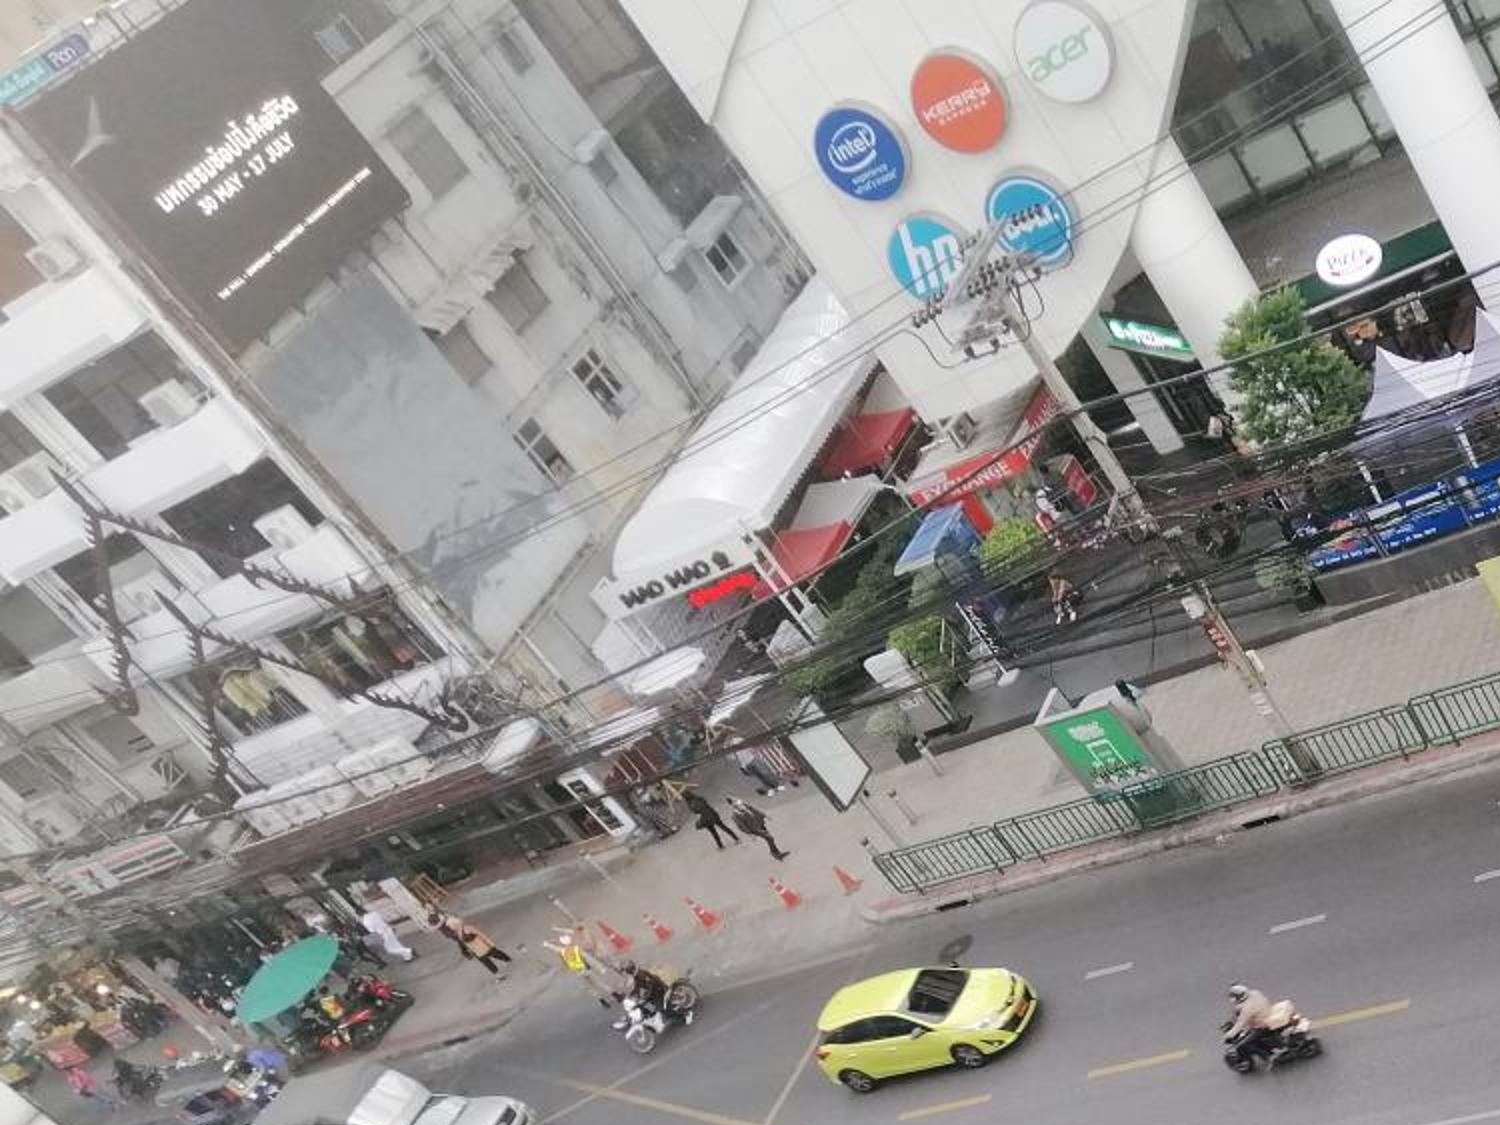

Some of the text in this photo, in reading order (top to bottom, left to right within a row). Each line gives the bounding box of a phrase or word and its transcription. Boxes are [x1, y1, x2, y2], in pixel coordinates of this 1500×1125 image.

[1027, 26, 1092, 82] acer
[923, 80, 992, 122] KERRY
[833, 128, 869, 163] intel
[197, 194, 219, 216] 30
[212, 171, 245, 204] MAY
[247, 154, 267, 176] 17
[264, 130, 295, 164] JULY
[897, 222, 966, 294] hp
[618, 557, 712, 609] MAO MAO
